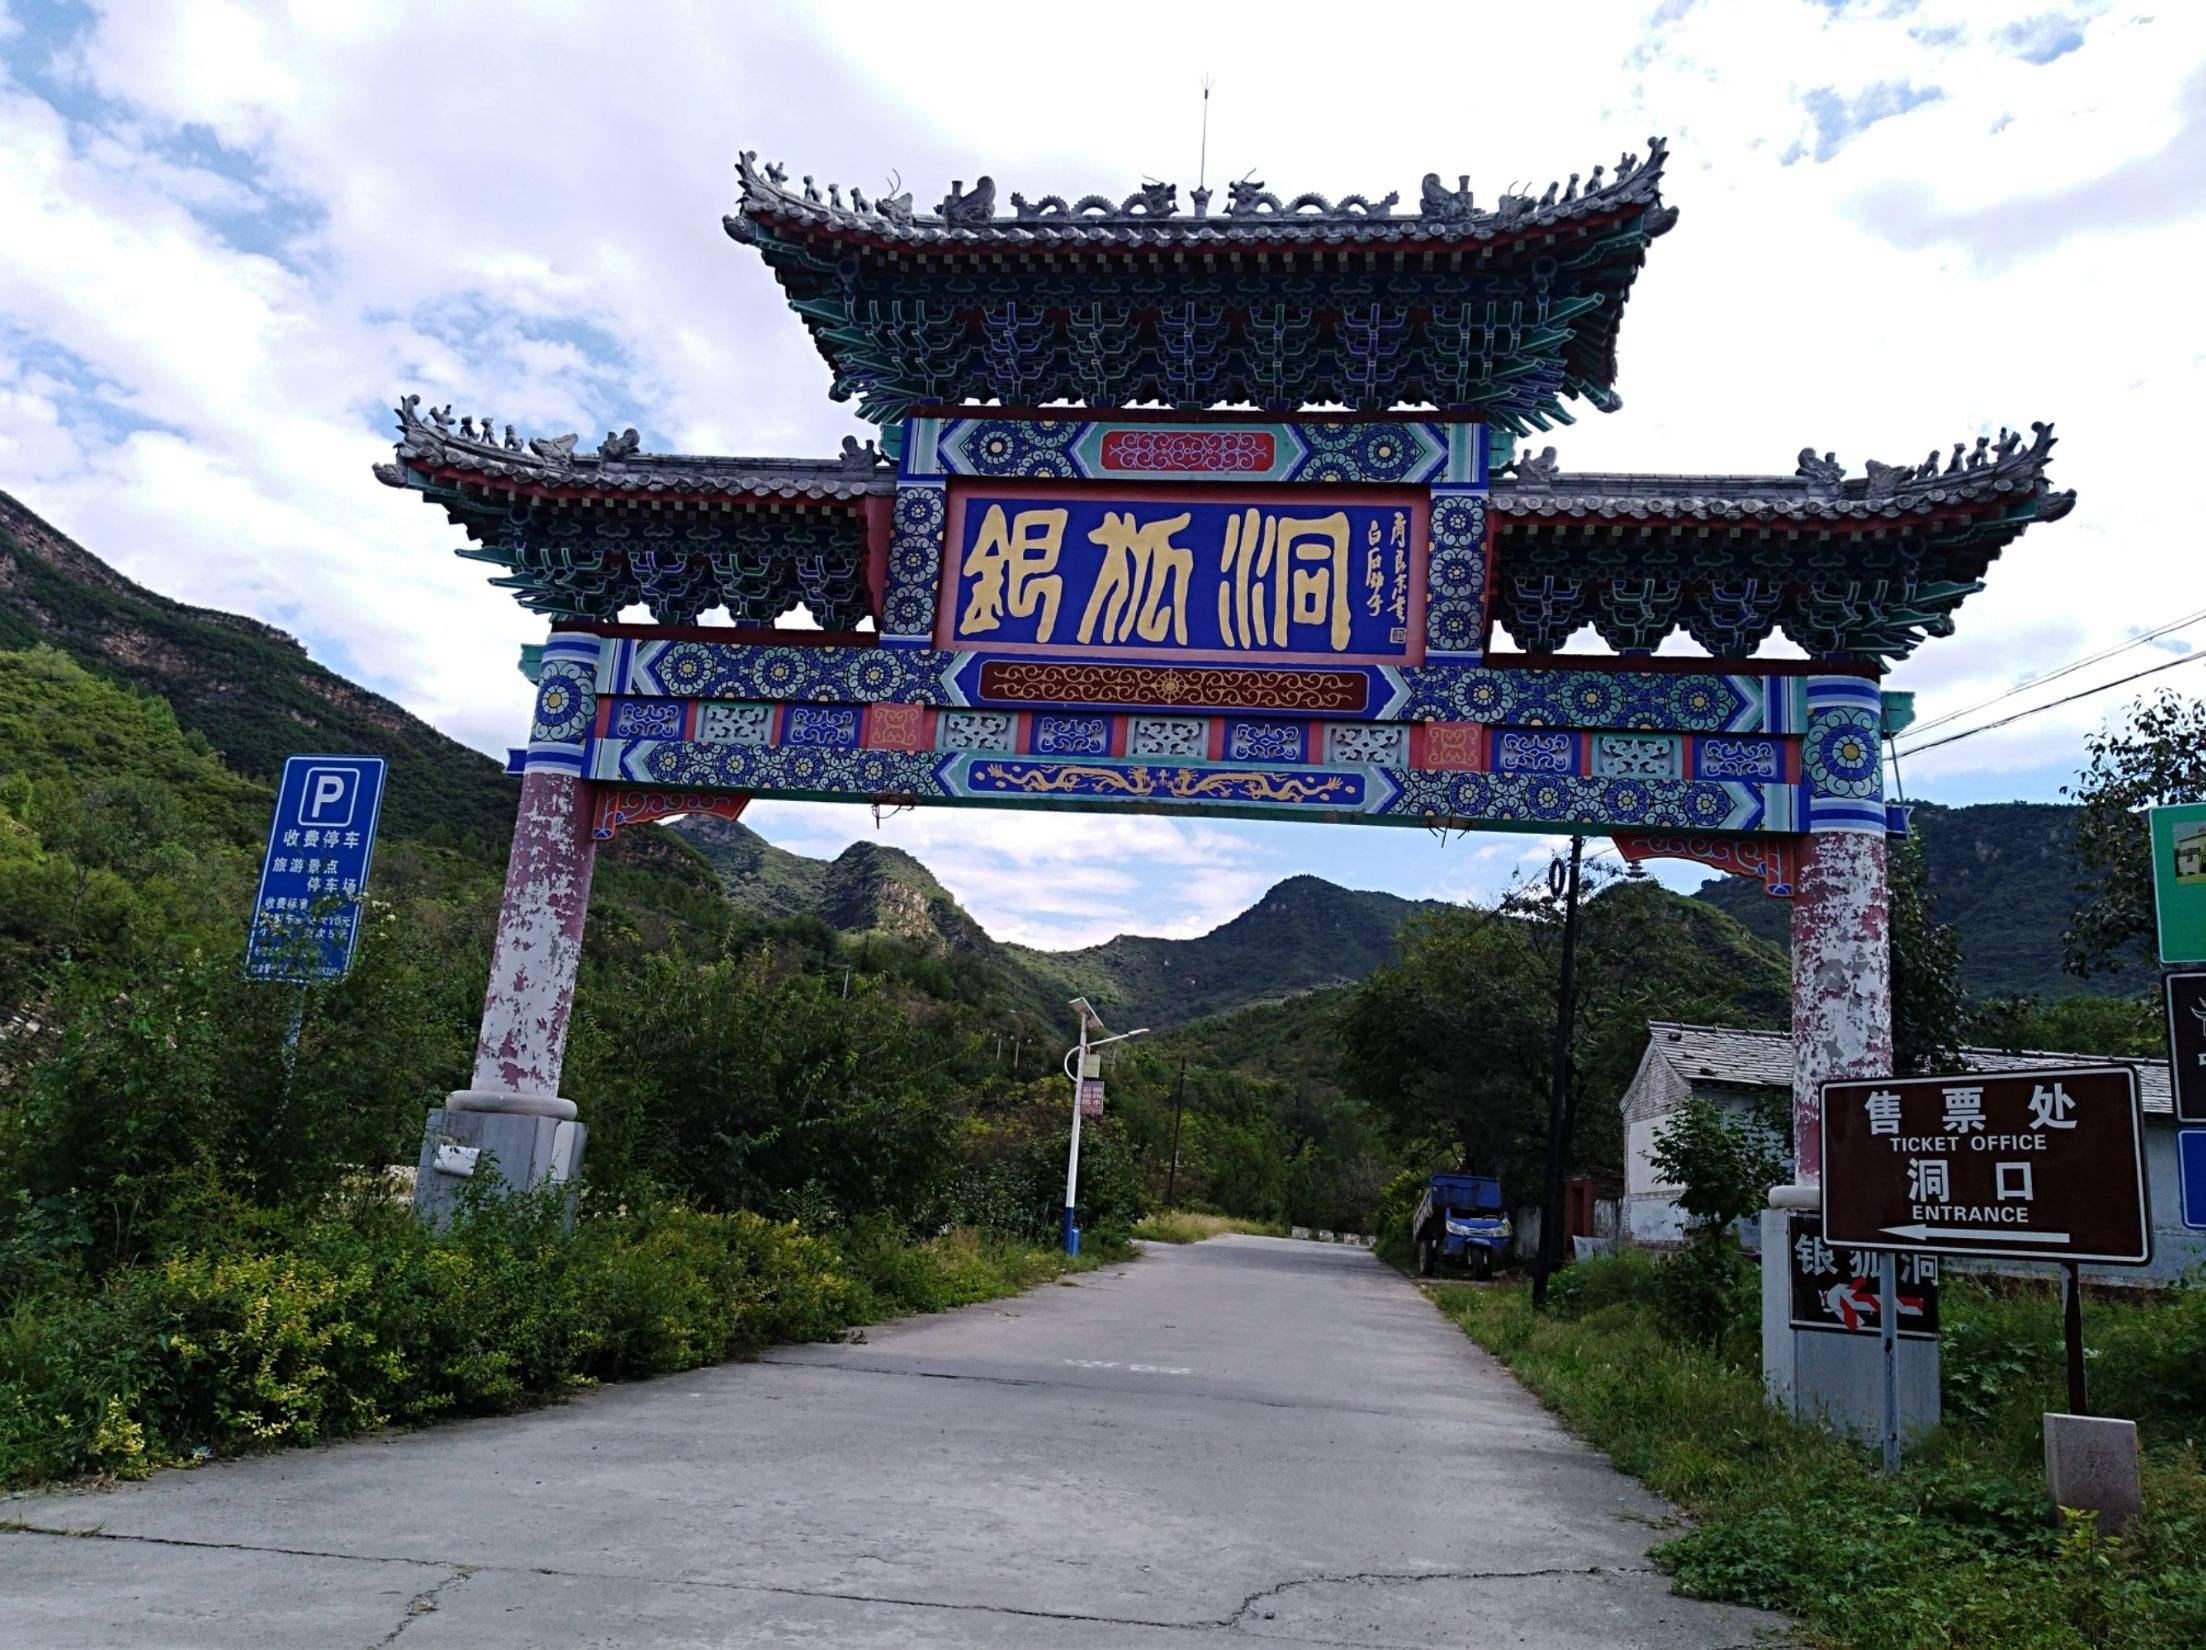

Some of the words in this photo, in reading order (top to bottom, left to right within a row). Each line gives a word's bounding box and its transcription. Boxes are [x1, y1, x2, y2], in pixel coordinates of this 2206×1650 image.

[311, 775, 345, 818] P
[283, 828, 360, 849] 收费停车
[272, 857, 339, 874] 旅游景点
[307, 876, 357, 900] 停车场
[1865, 1082, 2078, 1135] 售票处
[1890, 1137, 1959, 1152] TICKET
[1971, 1134, 2047, 1151] OFFICE
[1907, 1158, 2034, 1202] 洞口
[1912, 1205, 2029, 1223] ENTRANCE
